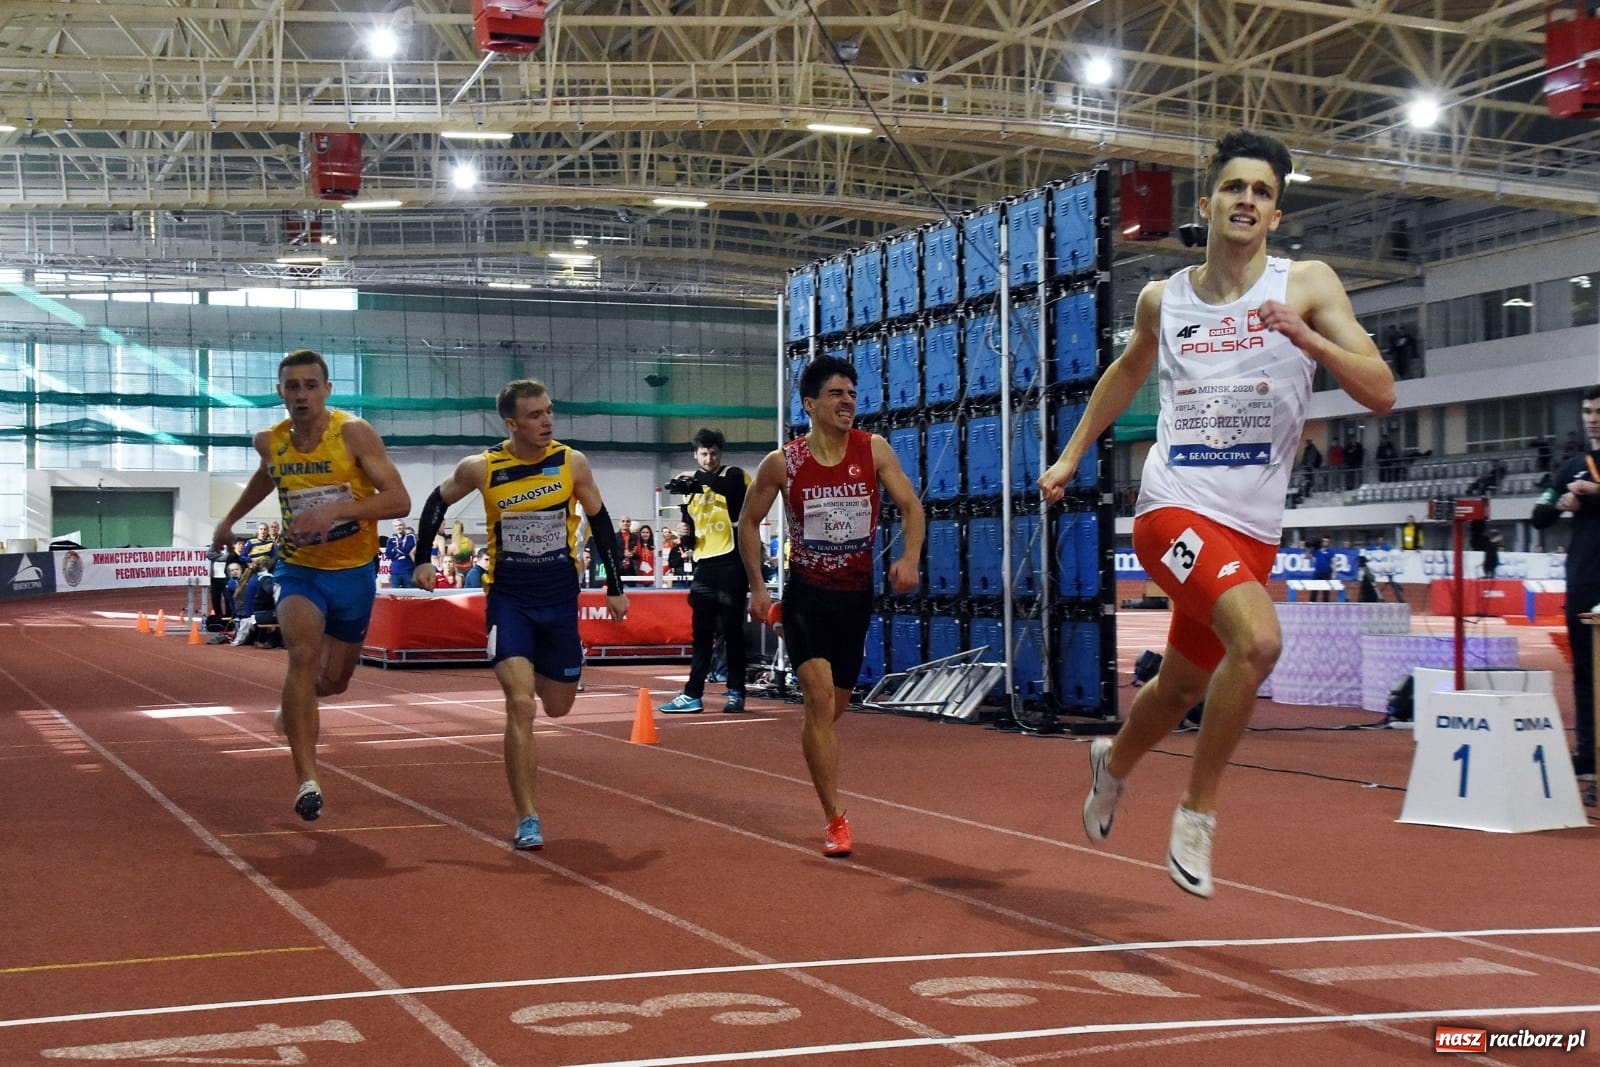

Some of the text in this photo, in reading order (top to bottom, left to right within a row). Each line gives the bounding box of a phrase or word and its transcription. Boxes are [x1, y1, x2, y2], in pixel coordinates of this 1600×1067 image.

[1177, 324, 1201, 338] 4F
[1210, 327, 1236, 336] ORLEN
[1181, 336, 1264, 355] POLSKA
[1198, 385, 1230, 394] MINSK
[1232, 384, 1254, 393] 2020
[1174, 415, 1271, 430] GRZEGORZEWICZ
[280, 460, 333, 476] UKRAINE
[497, 482, 563, 509] QAZAQSTAN
[802, 482, 868, 500] TÜRKİYE
[824, 521, 852, 530] KAYA
[508, 531, 560, 543] TARASSOV
[93, 551, 154, 565] МИНИСТЕРСТВО
[155, 551, 185, 563] СПОРТА
[187, 551, 193, 561] И
[1173, 541, 1195, 569] 3
[115, 565, 208, 580] РЕСПУБЛИКИ БЕЛАРУСЬ
[1436, 715, 1491, 731] DIMA
[1513, 717, 1554, 731] DIMA
[1453, 744, 1471, 798] 1
[1533, 744, 1551, 798] 1
